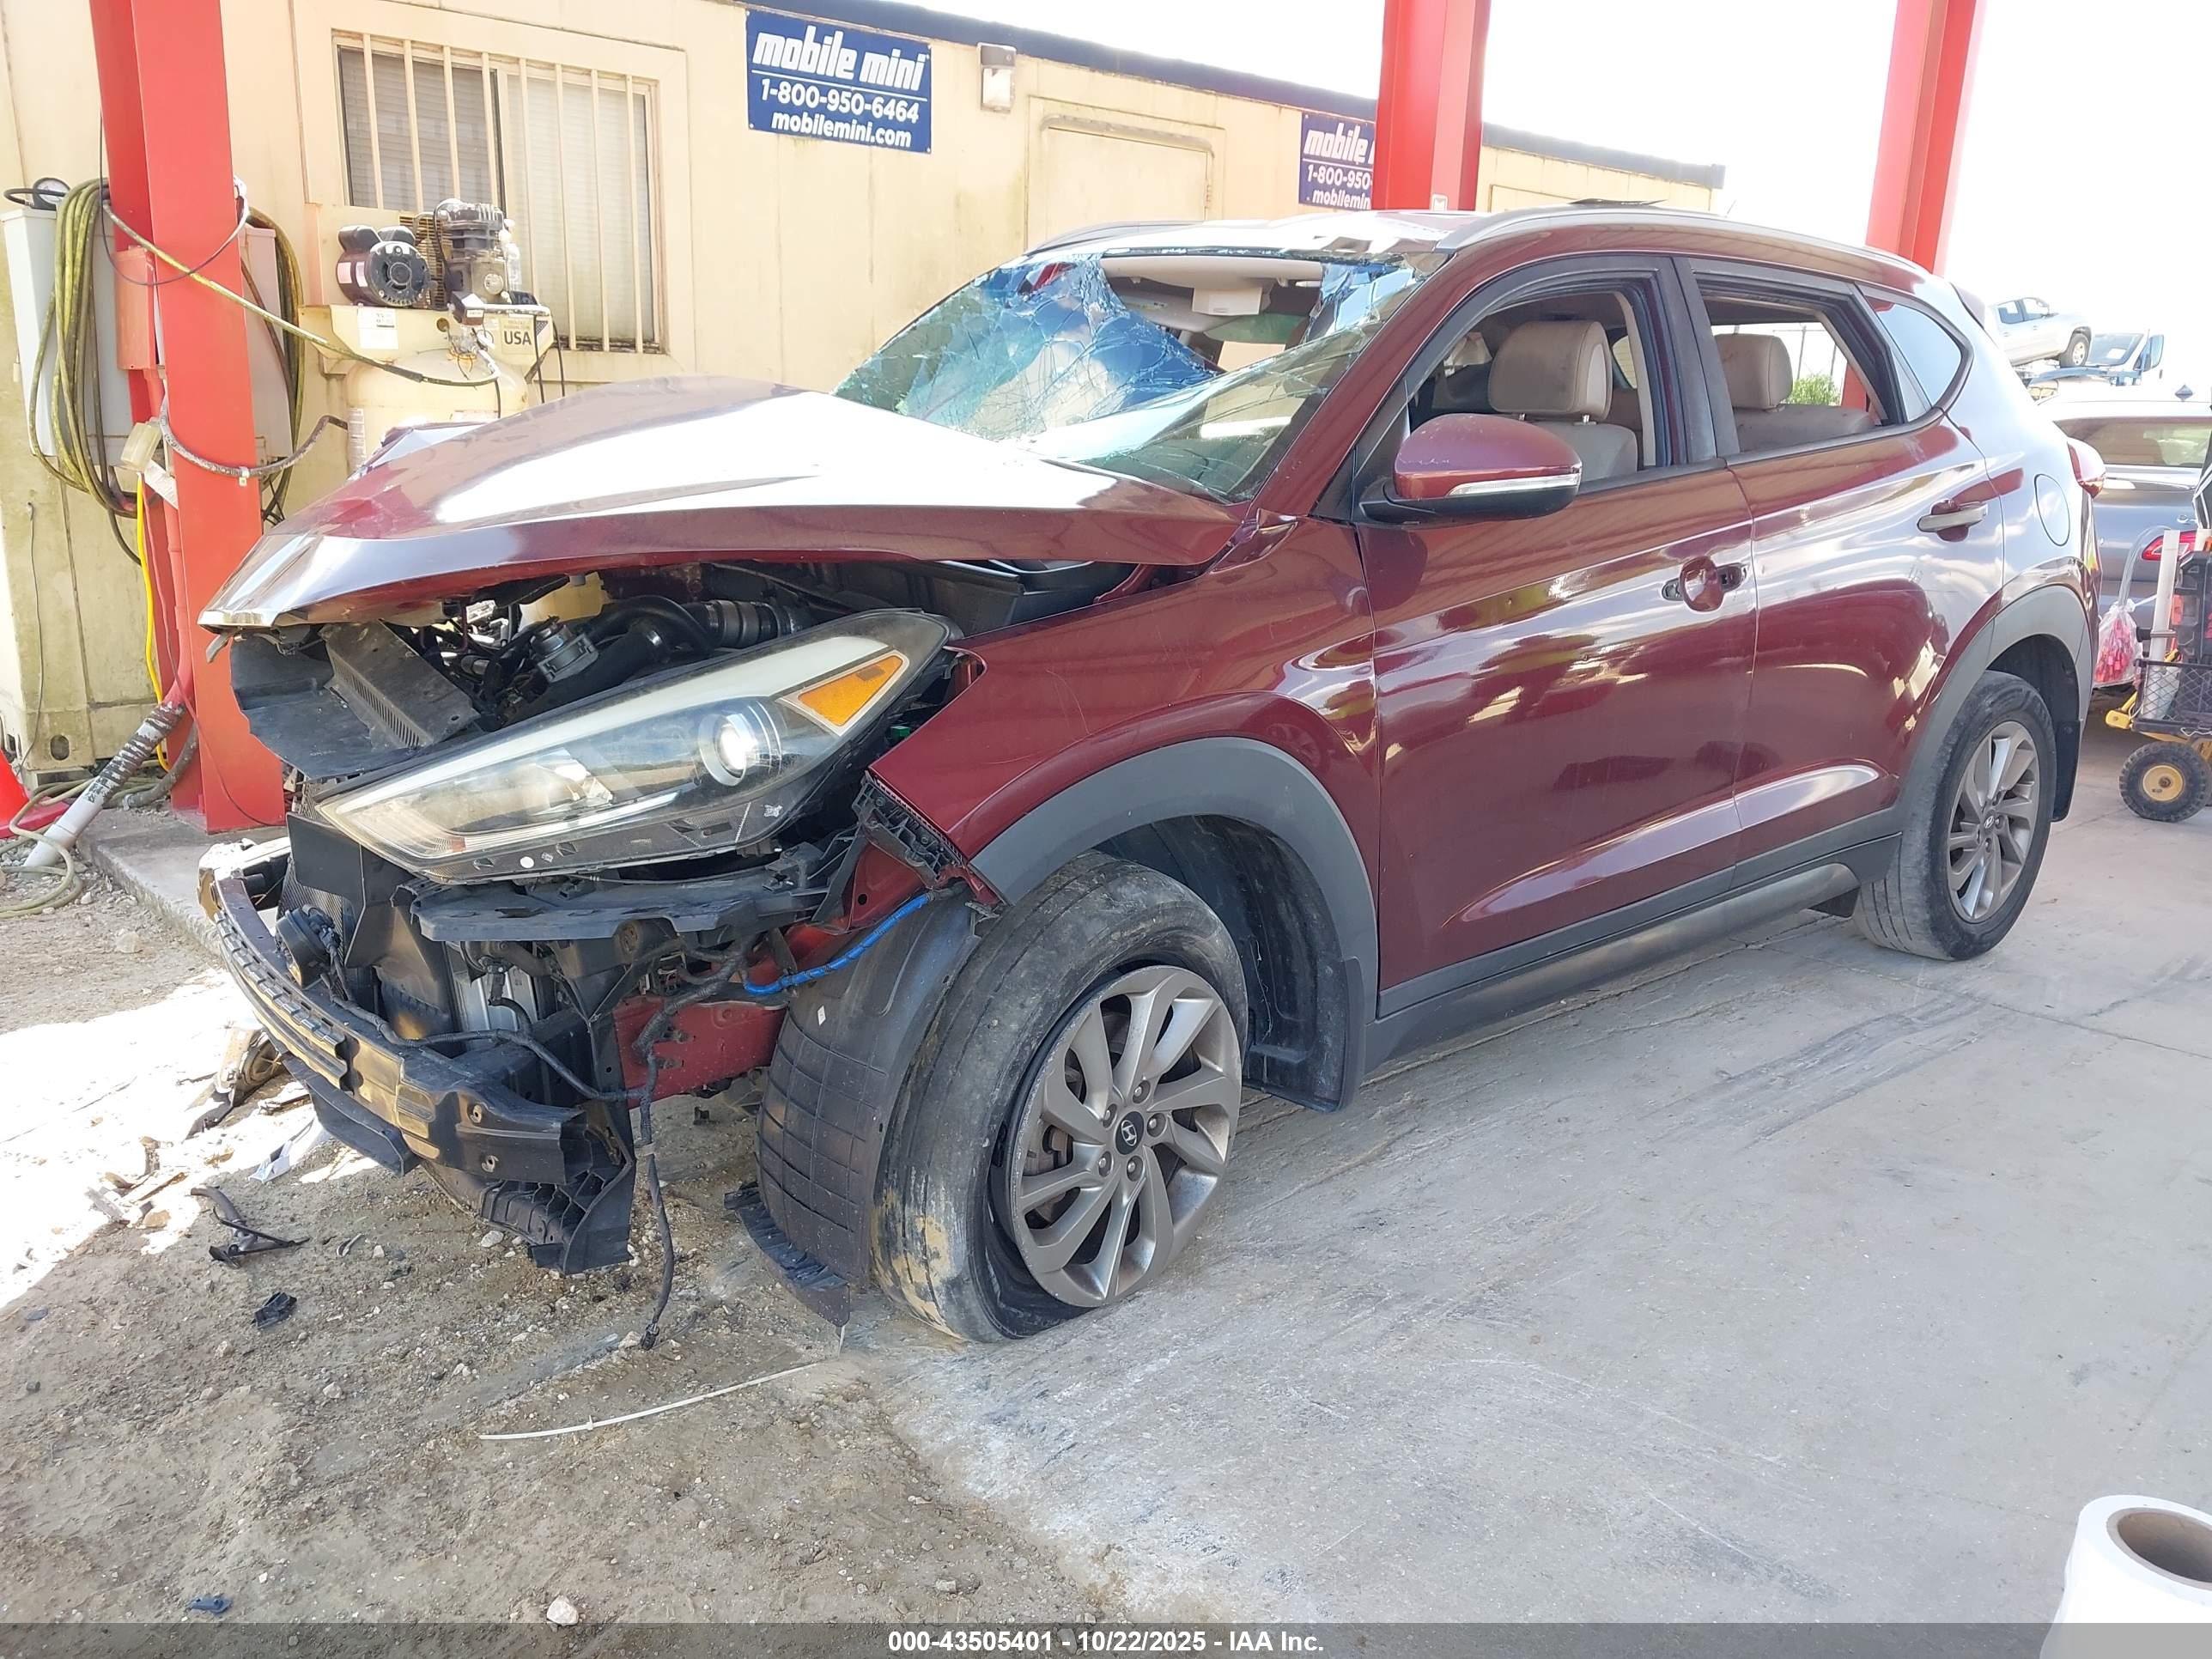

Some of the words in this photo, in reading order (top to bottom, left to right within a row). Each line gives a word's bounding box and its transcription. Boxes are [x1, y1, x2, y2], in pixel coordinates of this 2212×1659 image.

[752, 25, 857, 80] mobile
[859, 48, 927, 91] mini
[761, 78, 920, 124] 1-800-950-6464
[771, 112, 912, 148] mobilemini.com
[1304, 122, 1369, 163] mobile
[504, 331, 532, 345] USA
